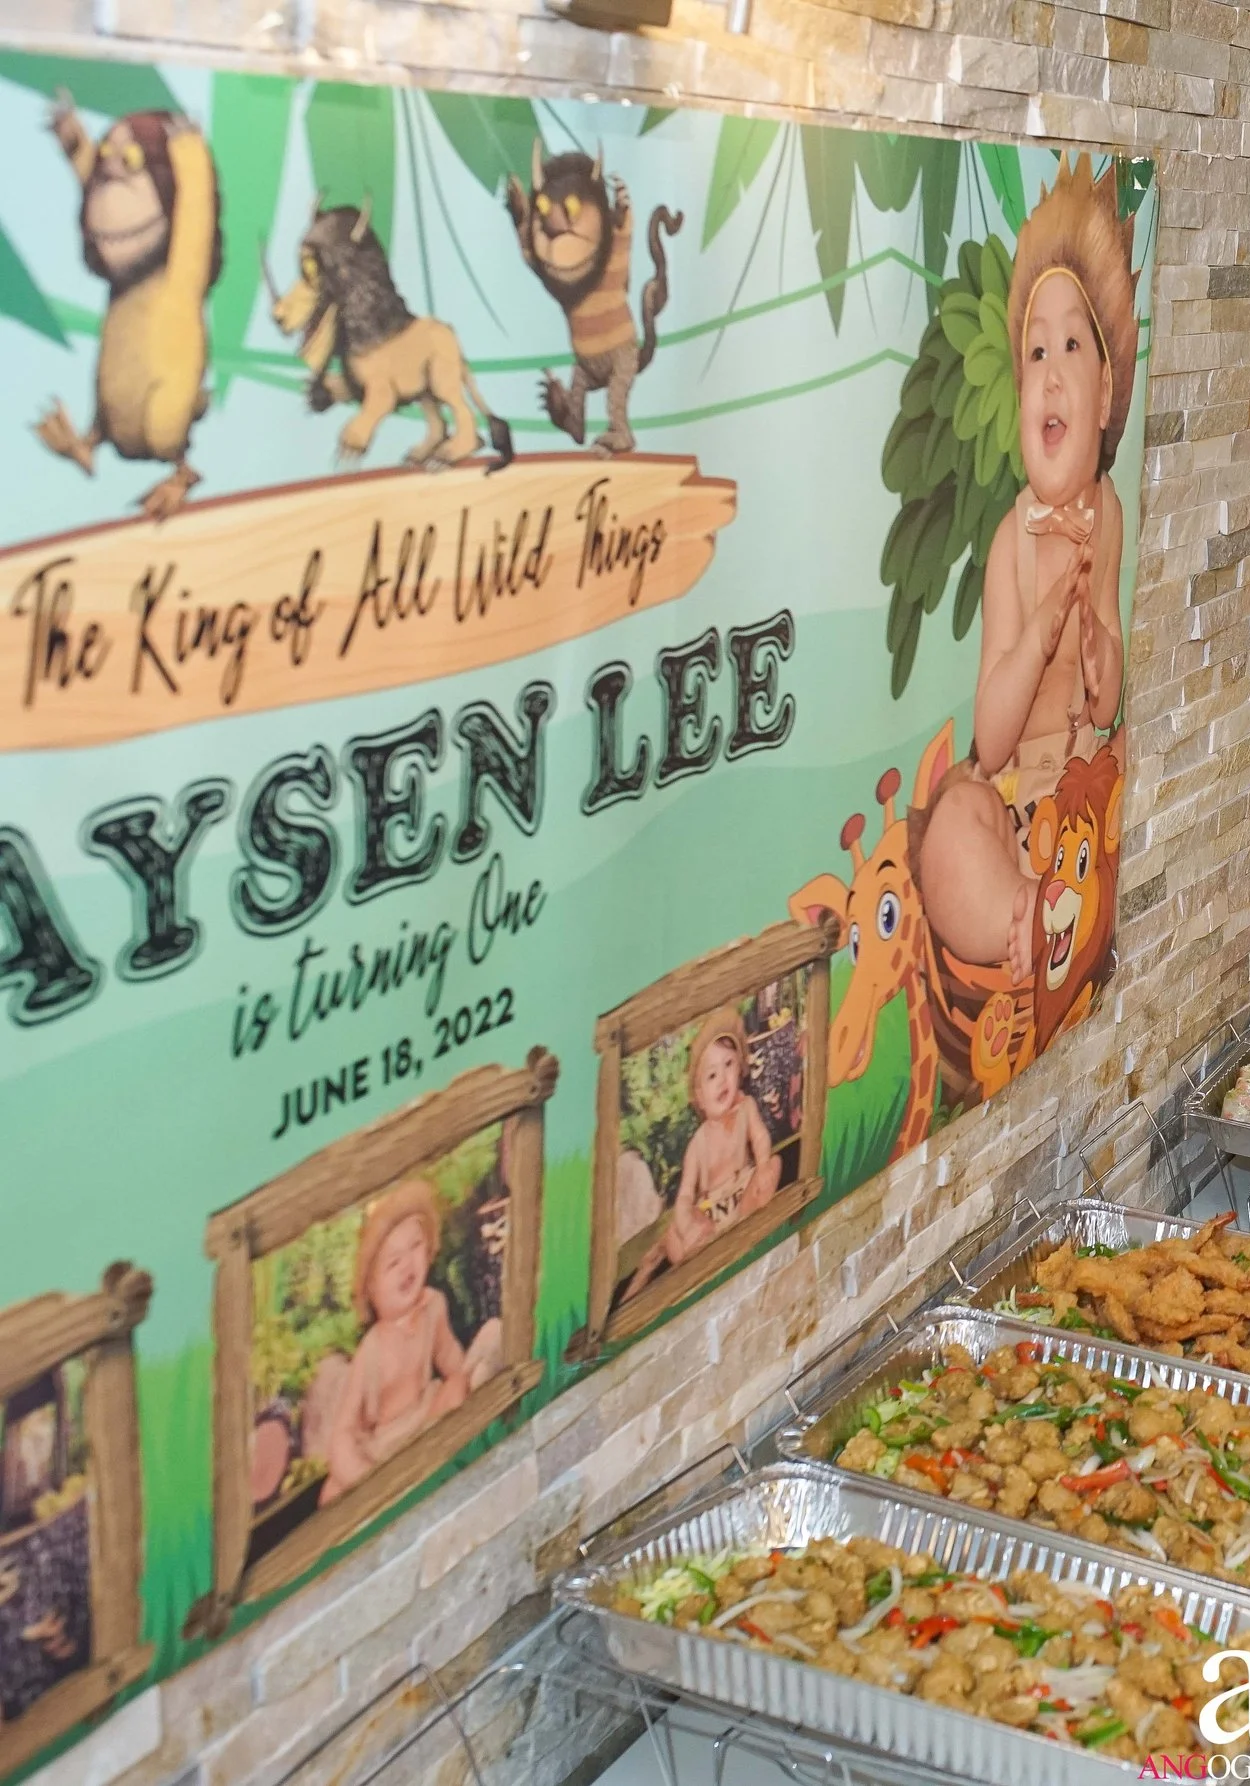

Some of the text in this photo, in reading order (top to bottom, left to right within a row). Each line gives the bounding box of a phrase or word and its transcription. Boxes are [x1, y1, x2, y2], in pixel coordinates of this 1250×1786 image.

[9, 477, 668, 711] The King of All Wild Things
[581, 607, 798, 817] LEE
[231, 850, 548, 1061] is turning One
[271, 986, 515, 1140] JUNE 18, 2022
